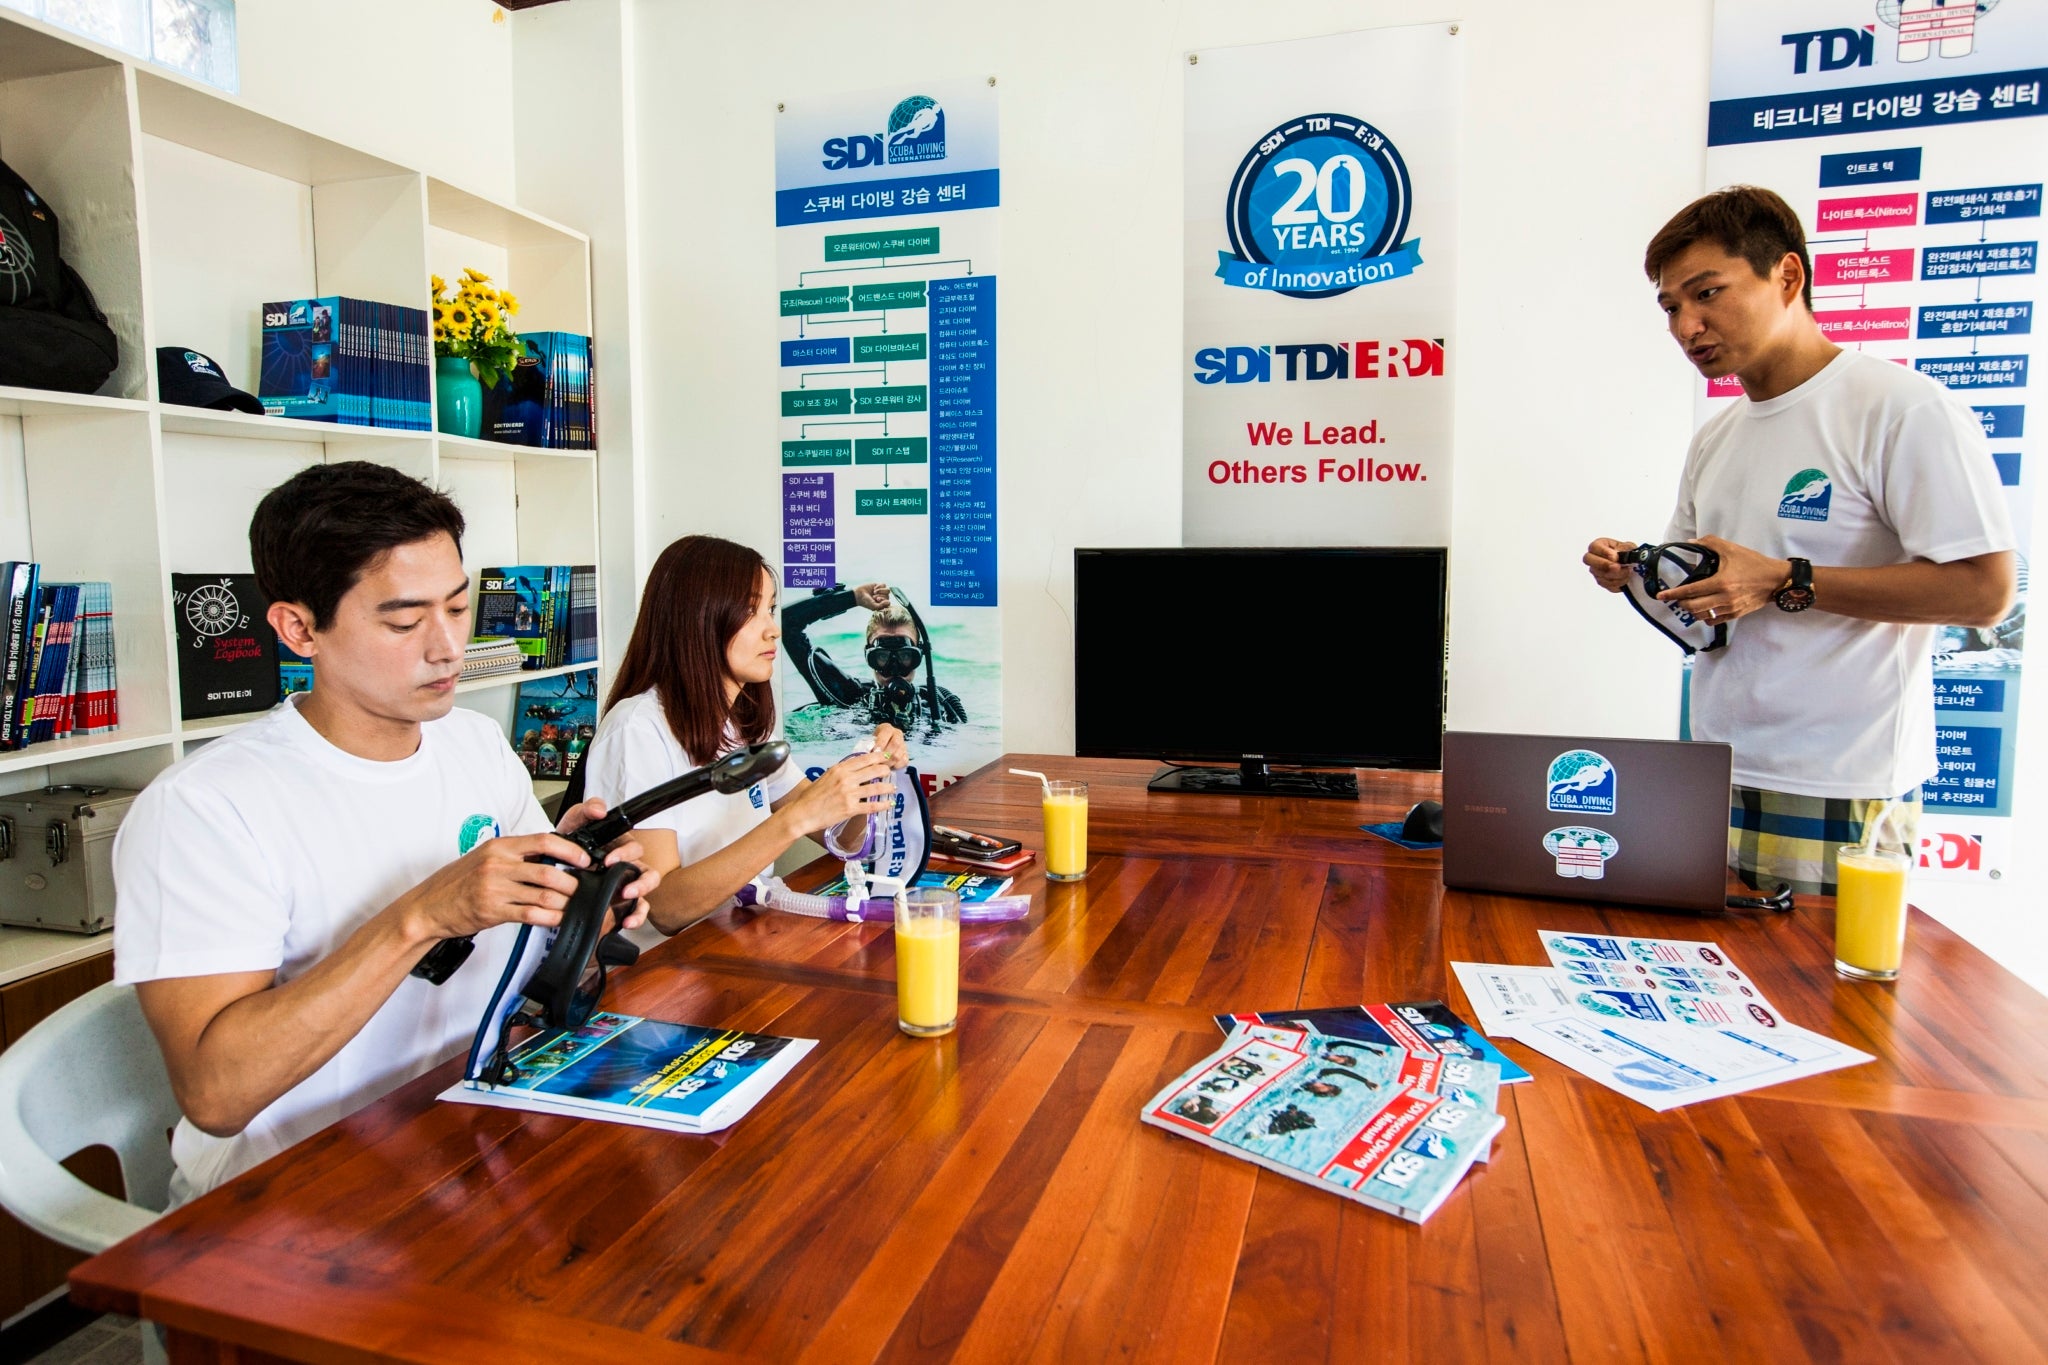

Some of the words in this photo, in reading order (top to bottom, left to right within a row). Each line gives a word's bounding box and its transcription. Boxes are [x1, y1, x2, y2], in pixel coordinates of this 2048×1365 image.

[1904, 28, 1965, 40] INTERNATIONAL
[1781, 25, 1875, 74] TDI
[1753, 102, 1843, 130] 테크니컬
[1852, 94, 1922, 122] 다이빙
[1932, 88, 1981, 115] 강습
[1989, 82, 2040, 109] 센터
[1259, 131, 1286, 156] SDI
[1305, 117, 1331, 132] TDI
[1354, 124, 1385, 151] ERDI
[822, 133, 884, 170] SDI
[889, 143, 914, 158] SCUBA
[917, 141, 945, 156] DIVING
[889, 153, 945, 163] INTERNATIONAL
[1847, 162, 1879, 175] 인트로
[1272, 154, 1366, 226] 20
[803, 194, 846, 213] 스쿠버
[852, 189, 895, 209] 다이빙
[901, 187, 931, 206] 강습
[936, 183, 966, 202] 센터
[1272, 222, 1365, 250] YEARS
[833, 240, 881, 252] 오픈워터(OW)
[883, 239, 905, 249] 스쿠버
[907, 237, 930, 247] 다이버
[1244, 267, 1268, 287] of
[1272, 261, 1394, 288] Innovation
[782, 296, 823, 308] 구조(Rescue)
[825, 295, 847, 305] 다이버
[898, 290, 920, 300] 다이버
[265, 312, 288, 327] SDI
[792, 348, 814, 357] 마스터
[816, 347, 837, 356] 다이버
[860, 345, 873, 354] SDI
[875, 343, 919, 353] 다이브마스터
[1193, 345, 1271, 385] SDI
[1275, 342, 1349, 381] TDI
[1355, 338, 1444, 379] ERDI
[793, 399, 805, 408] SDI
[807, 399, 821, 408] 보조
[823, 398, 838, 407] 강사
[860, 397, 872, 405] SDI
[875, 396, 904, 405] 오픈워터
[906, 395, 921, 404] 강사
[1247, 421, 1293, 446] We
[1304, 419, 1386, 445] Lead.
[784, 450, 796, 458] SDI
[835, 448, 850, 457] 강사
[871, 448, 884, 456] SDI
[1208, 460, 1307, 485] Others
[1318, 458, 1427, 483] Follow.
[789, 477, 800, 485] SDI
[789, 491, 810, 499] 스쿠버
[806, 504, 820, 512] 버디
[861, 498, 874, 507] SDI
[876, 498, 890, 506] 강사
[892, 497, 922, 506] 트레이너
[1779, 504, 1800, 514] SCUBA
[1802, 506, 1828, 517] DIVING
[790, 528, 812, 536] 다이버
[810, 543, 832, 551] 다이버
[802, 554, 817, 562] 과정
[485, 580, 502, 591] SDI
[792, 578, 827, 587] (Scubility)
[12, 616, 21, 632] 강사
[193, 635, 206, 649] S
[213, 637, 256, 650] System
[213, 645, 263, 662] Logbook
[207, 692, 221, 701] SDI
[222, 691, 236, 700] TDI
[1950, 684, 1984, 695] 서비스
[1550, 793, 1578, 804] SCUBA
[1582, 795, 1612, 807] DIVING
[1941, 791, 1985, 804] 추진장치
[1464, 804, 1507, 815] SAMSUNG
[1550, 803, 1612, 811] INTERNATIONAL
[1919, 832, 1982, 871] RDI
[696, 1049, 715, 1060] SDI
[715, 1040, 756, 1062] SDI
[1421, 1061, 1435, 1073] SDI
[1442, 1062, 1473, 1087] SDI
[662, 1077, 707, 1100] SDI
[1416, 1073, 1432, 1091] Resc
[1407, 1100, 1428, 1116] SDI
[1423, 1105, 1469, 1134] SDI
[1360, 1111, 1397, 1145] Manual
[1381, 1112, 1416, 1141] Rescue
[1352, 1138, 1391, 1170] Diving
[1375, 1151, 1425, 1189] SDI
